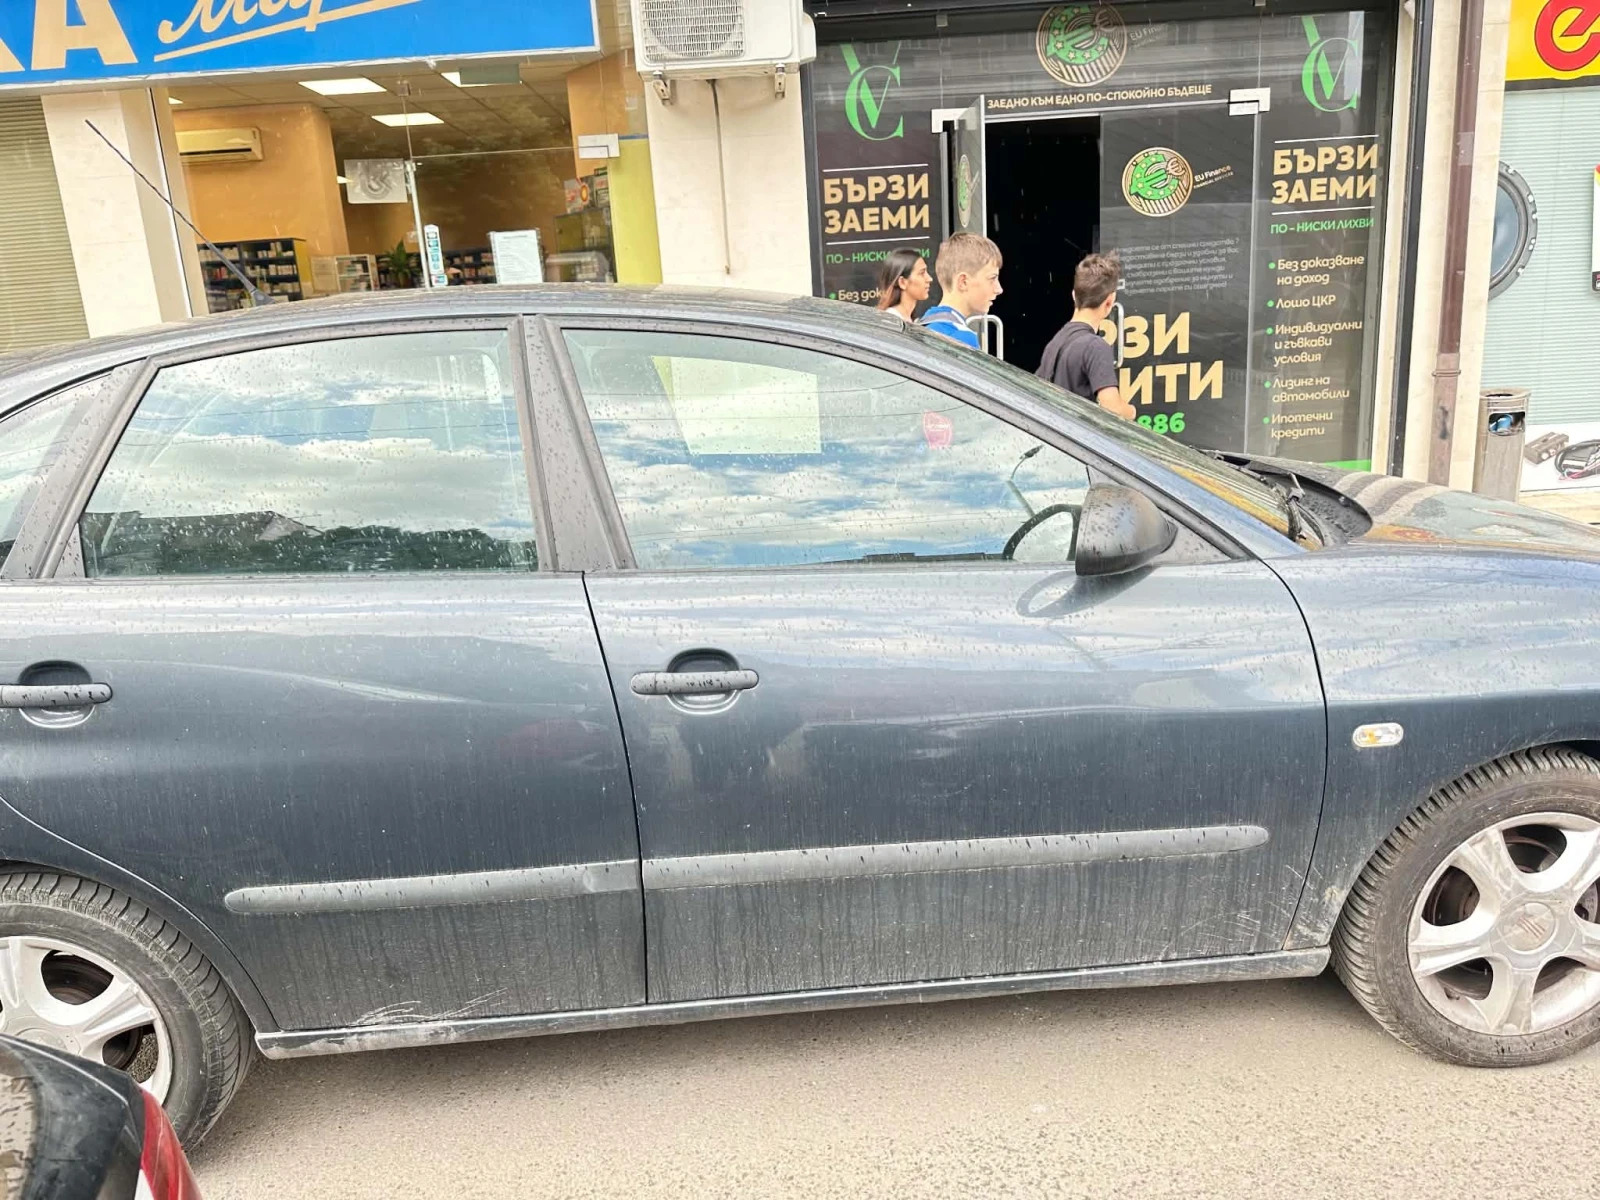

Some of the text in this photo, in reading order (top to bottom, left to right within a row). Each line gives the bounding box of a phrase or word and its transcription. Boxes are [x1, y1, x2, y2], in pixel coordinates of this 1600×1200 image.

[987, 84, 1212, 109] ЗАЕДНО КЪМ ЕДНО ПО-СПОКОЙНО БЪДЕЩЕ
[1273, 143, 1379, 176] БЪРЗИ
[1194, 165, 1231, 182] EU Finance
[823, 172, 929, 205] БЪРЗИ
[1270, 174, 1377, 205] ЗАЕМИ
[824, 204, 930, 235] ЗАЕМИ
[1270, 223, 1288, 235] ПО
[1296, 220, 1336, 233] НИСКИ
[1336, 217, 1375, 230] ЛИХВИ
[826, 253, 844, 265] ПО
[1277, 254, 1365, 271] Без доказване
[1277, 273, 1330, 286] на доход
[838, 289, 859, 302] Без
[1276, 294, 1336, 309] Лошо ЦКР
[1275, 321, 1363, 336] Индивидуални
[1274, 336, 1333, 349] и гъвкави
[1273, 351, 1322, 367] условия
[1273, 376, 1331, 389] Лизинг на
[1272, 388, 1350, 403] автомобили
[1271, 412, 1333, 424] Ипотечни
[1270, 426, 1326, 440] кредити
